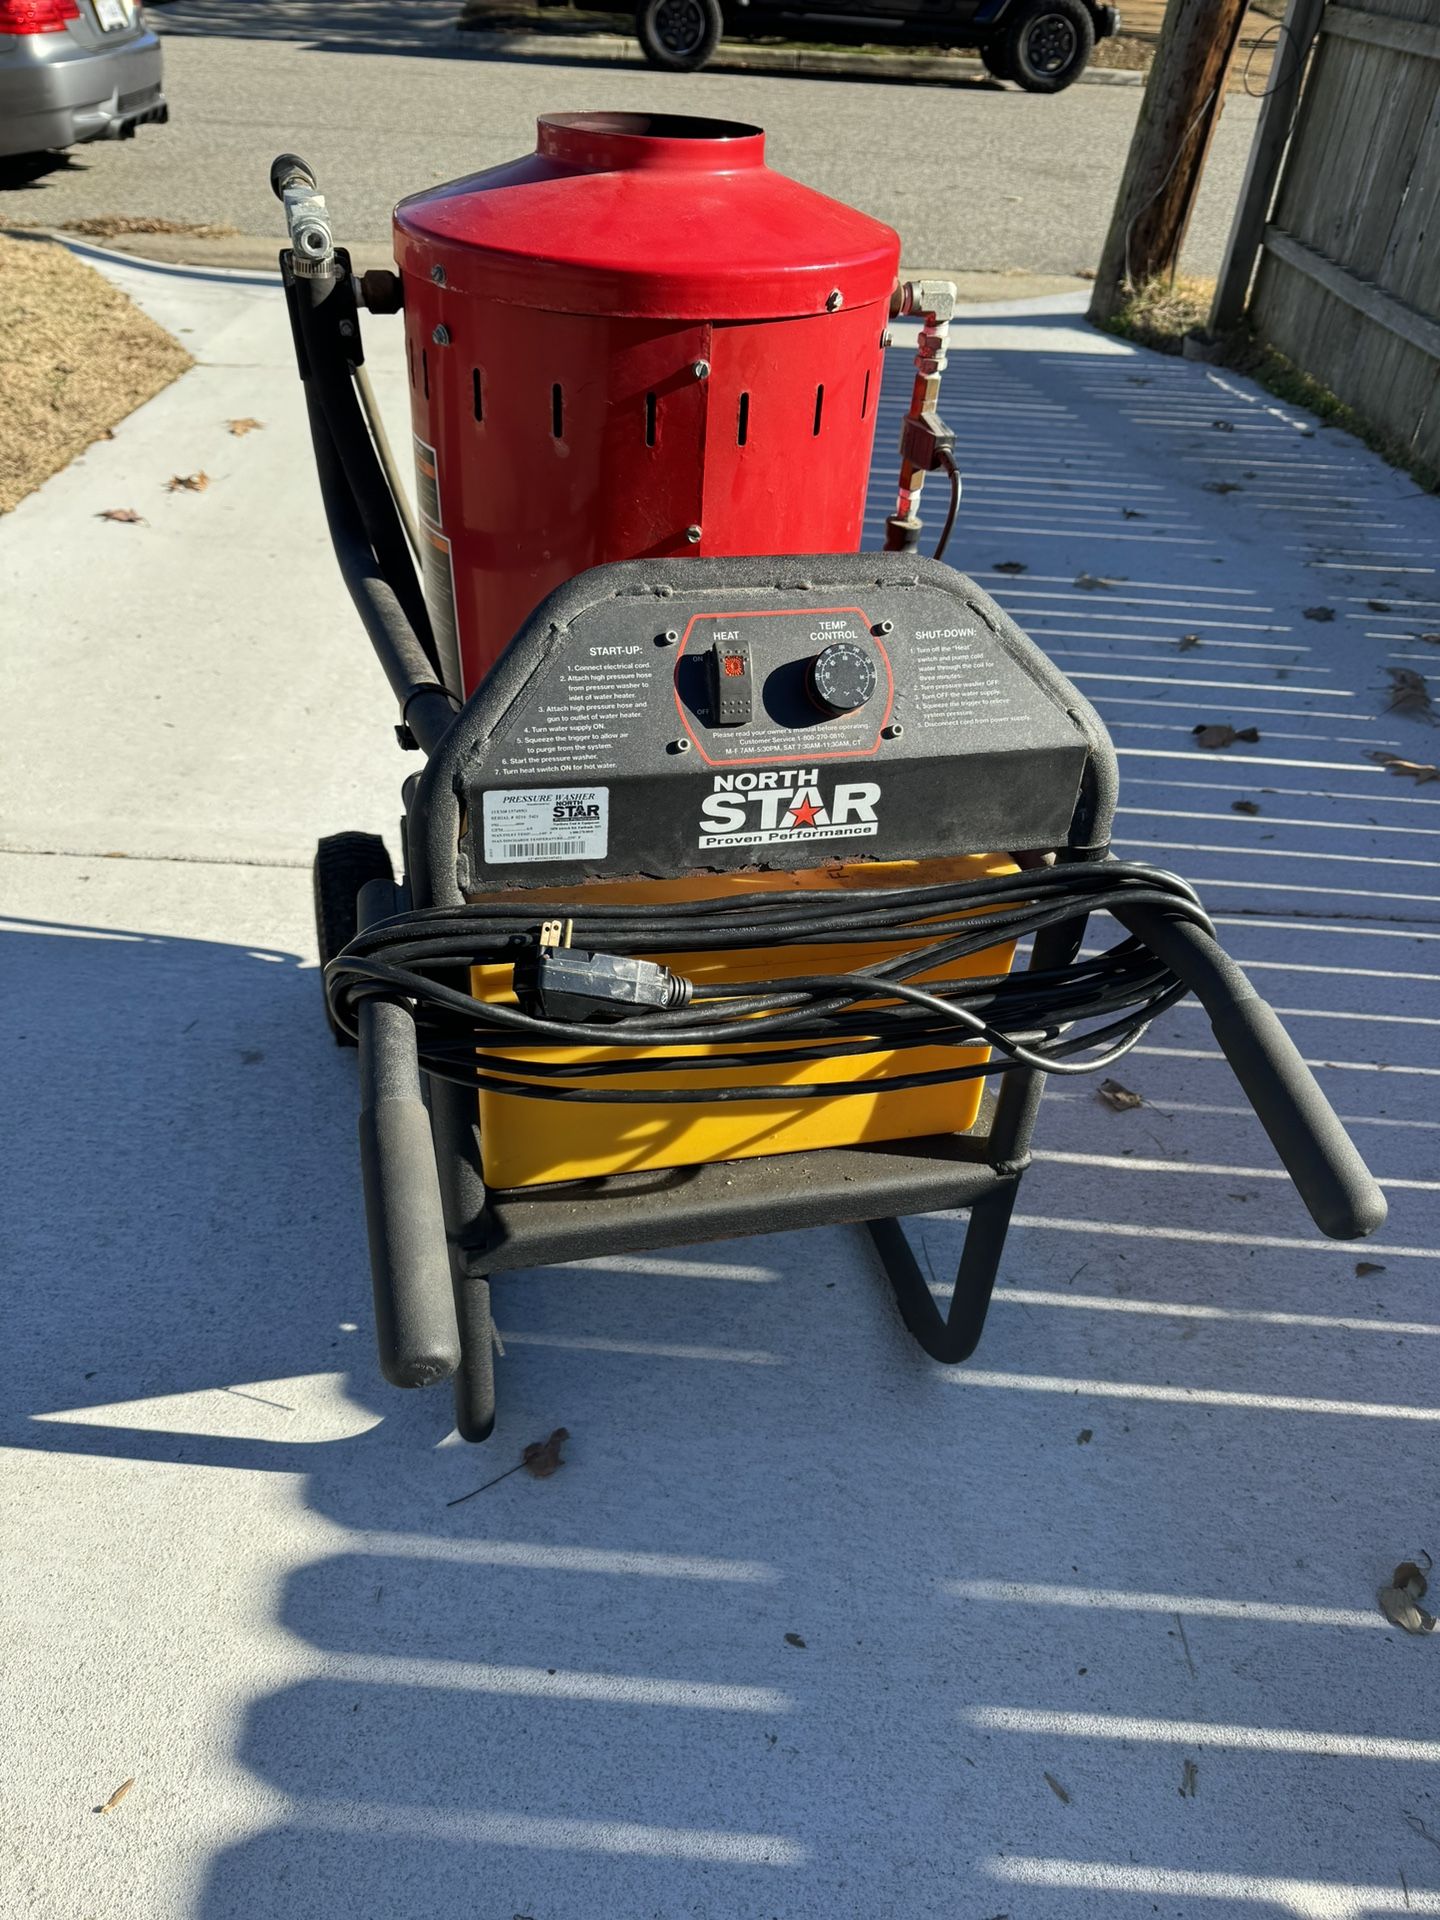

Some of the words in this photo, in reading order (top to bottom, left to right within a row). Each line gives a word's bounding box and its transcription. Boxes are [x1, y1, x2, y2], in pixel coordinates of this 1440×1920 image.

[819, 621, 847, 630] TEMP
[713, 631, 739, 640] HEAT
[810, 630, 858, 640] CONTROL
[915, 628, 977, 640] SHUT-DOWN:
[589, 646, 643, 656] START-UP:
[586, 703, 615, 711] pressure
[546, 716, 560, 724] gun
[713, 769, 818, 792] NORTH
[503, 794, 553, 803] PRESSURE
[556, 793, 595, 801] WASHER
[553, 804, 600, 818] STAR
[699, 782, 882, 834] STAR
[706, 835, 762, 846] Proven
[768, 826, 872, 842] Performance
